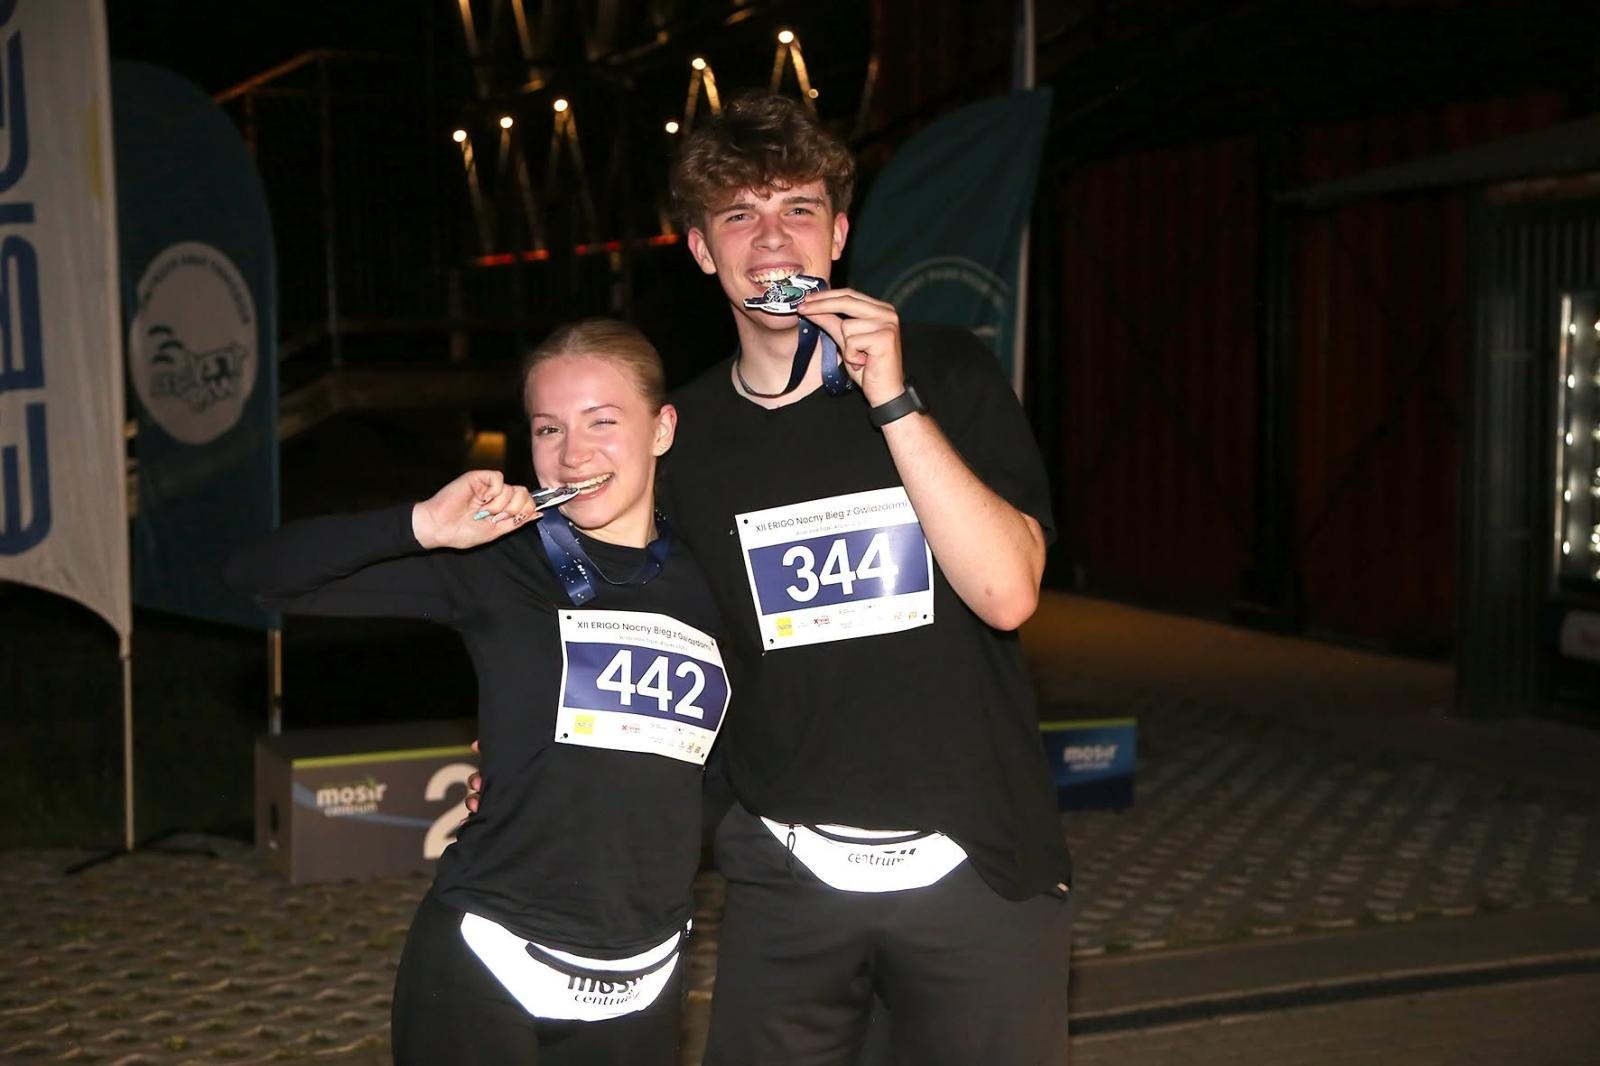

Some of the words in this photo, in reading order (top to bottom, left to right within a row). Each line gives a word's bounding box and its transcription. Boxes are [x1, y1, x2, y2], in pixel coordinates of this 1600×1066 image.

[755, 524, 767, 533] XII
[767, 518, 795, 531] ERIGO
[796, 513, 824, 526] Nocny
[825, 509, 845, 520] Bieg
[846, 509, 851, 517] z
[782, 532, 899, 603] 344
[577, 621, 589, 629] XII
[591, 621, 621, 630] ERIGO
[622, 623, 652, 635] Nocny
[653, 625, 672, 639] Bieg
[596, 649, 706, 720] 442
[316, 779, 387, 808] mosir
